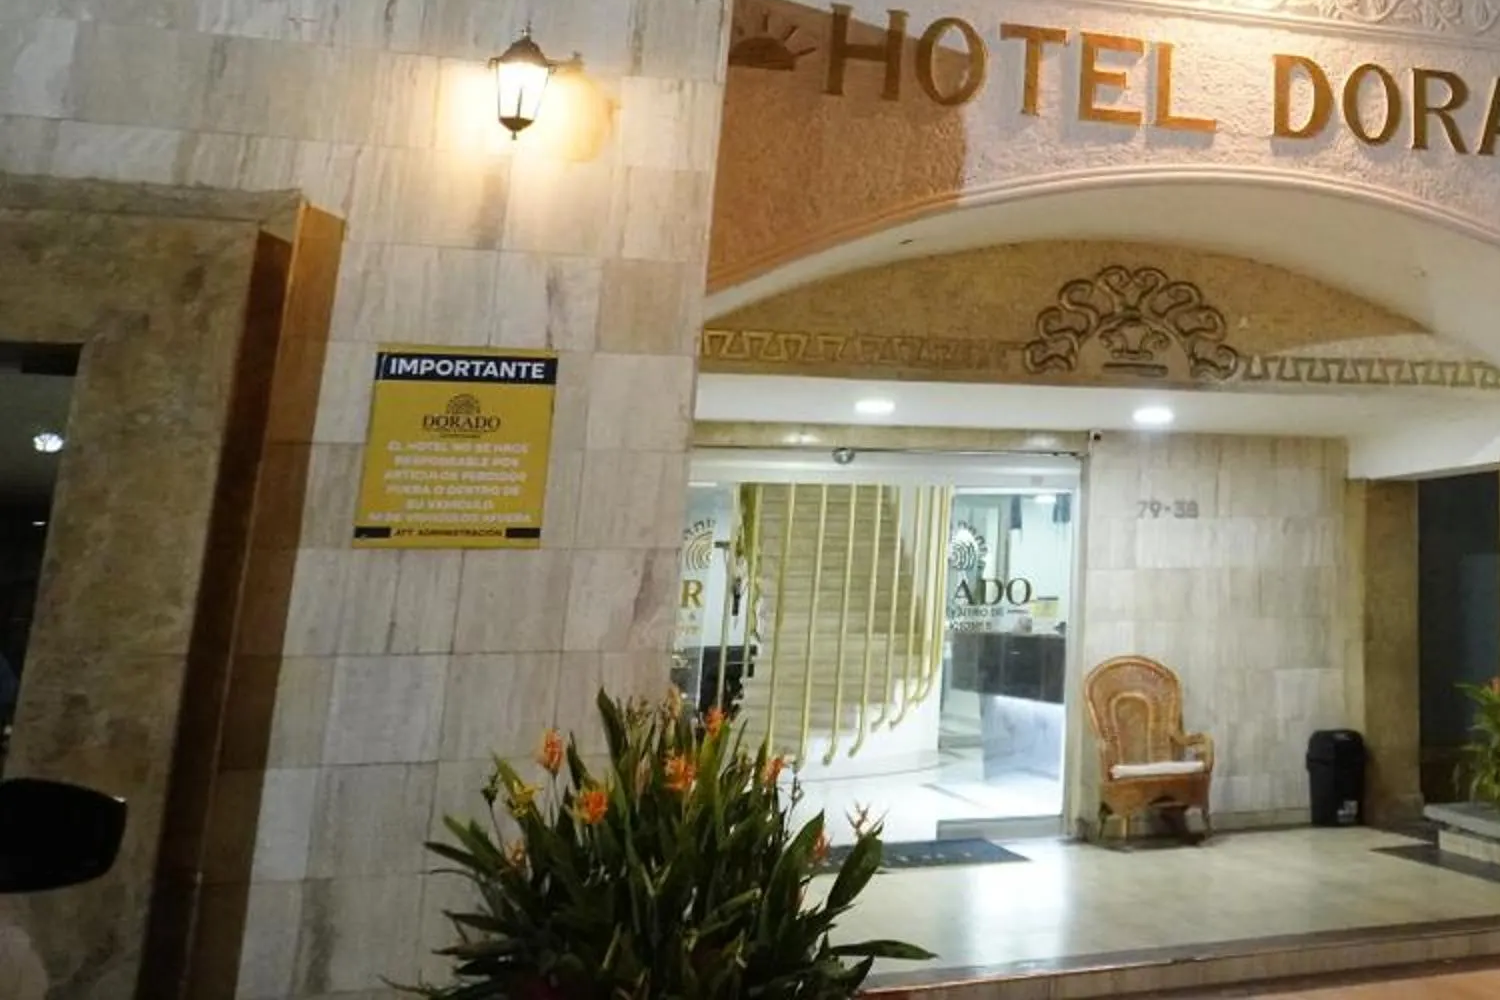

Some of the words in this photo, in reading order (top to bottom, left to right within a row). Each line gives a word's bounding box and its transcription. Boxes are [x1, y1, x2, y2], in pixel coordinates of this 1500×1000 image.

[821, 2, 1217, 134] HOTEL
[389, 357, 545, 379] IMPORTANTE
[422, 415, 501, 432] DORADO
